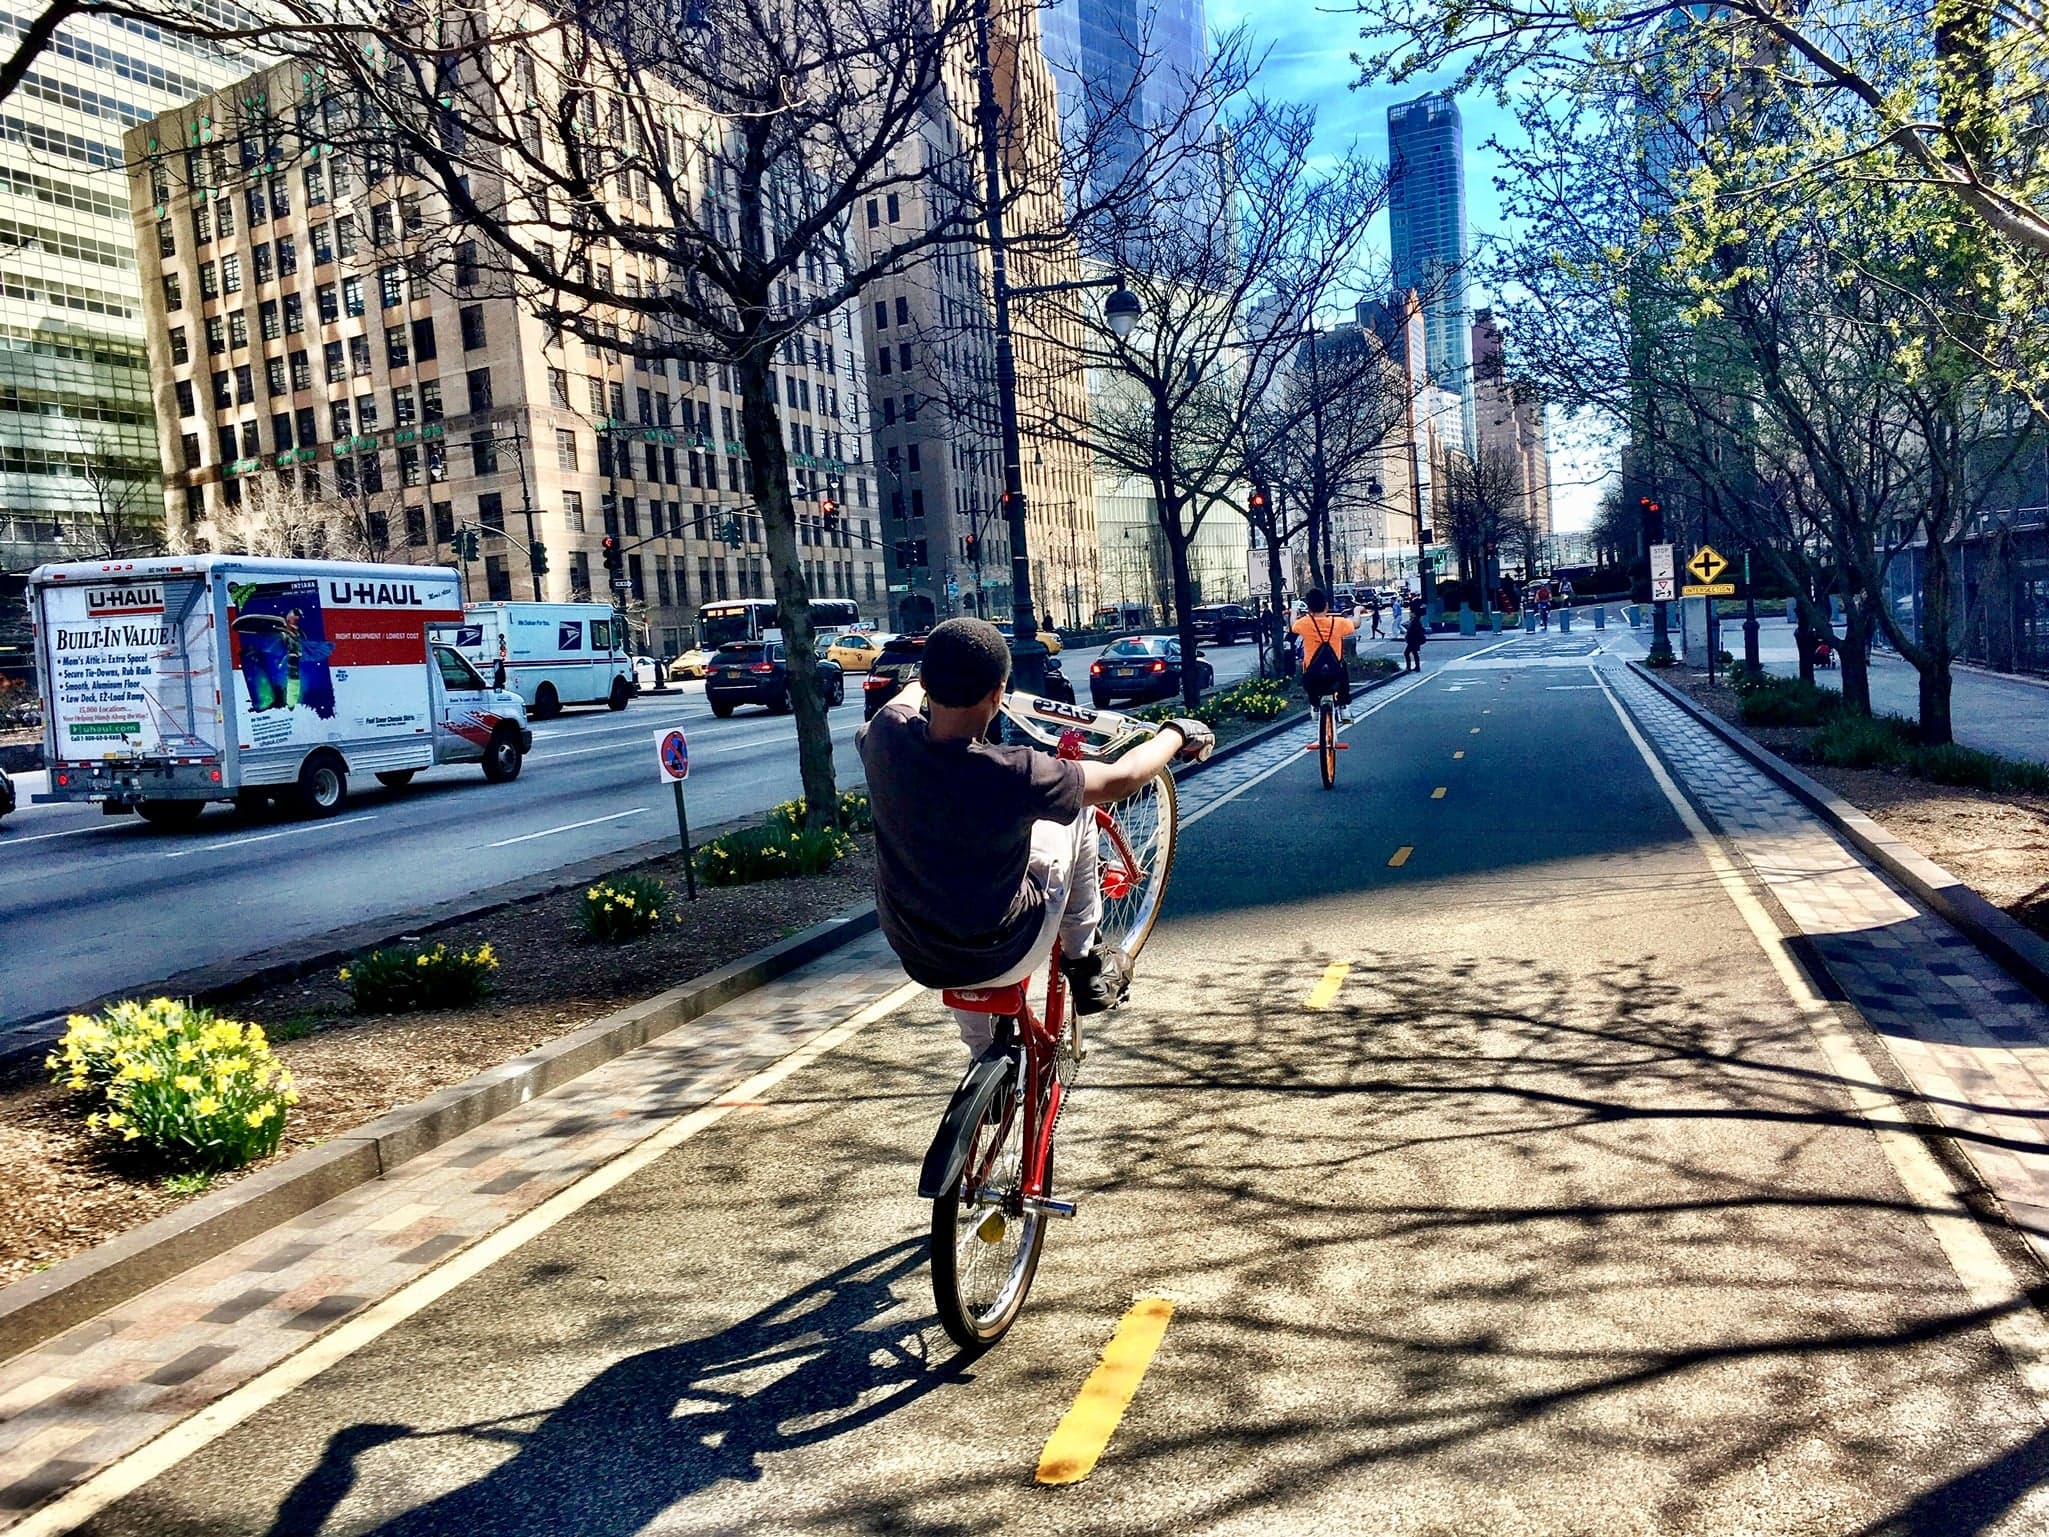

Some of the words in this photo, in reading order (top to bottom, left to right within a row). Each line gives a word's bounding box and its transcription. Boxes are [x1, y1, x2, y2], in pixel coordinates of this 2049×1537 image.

[330, 582, 423, 605] U-HAUL
[1686, 586, 1731, 594] INTERSECTION
[88, 589, 163, 607] U-HAUL
[108, 654, 126, 664] Extra
[64, 669, 84, 679] Secure
[92, 680, 122, 690] Aluminum
[124, 679, 141, 688] Floor
[66, 694, 79, 703] Low
[127, 691, 145, 703] Ramp
[83, 725, 137, 733] uhaul.com
